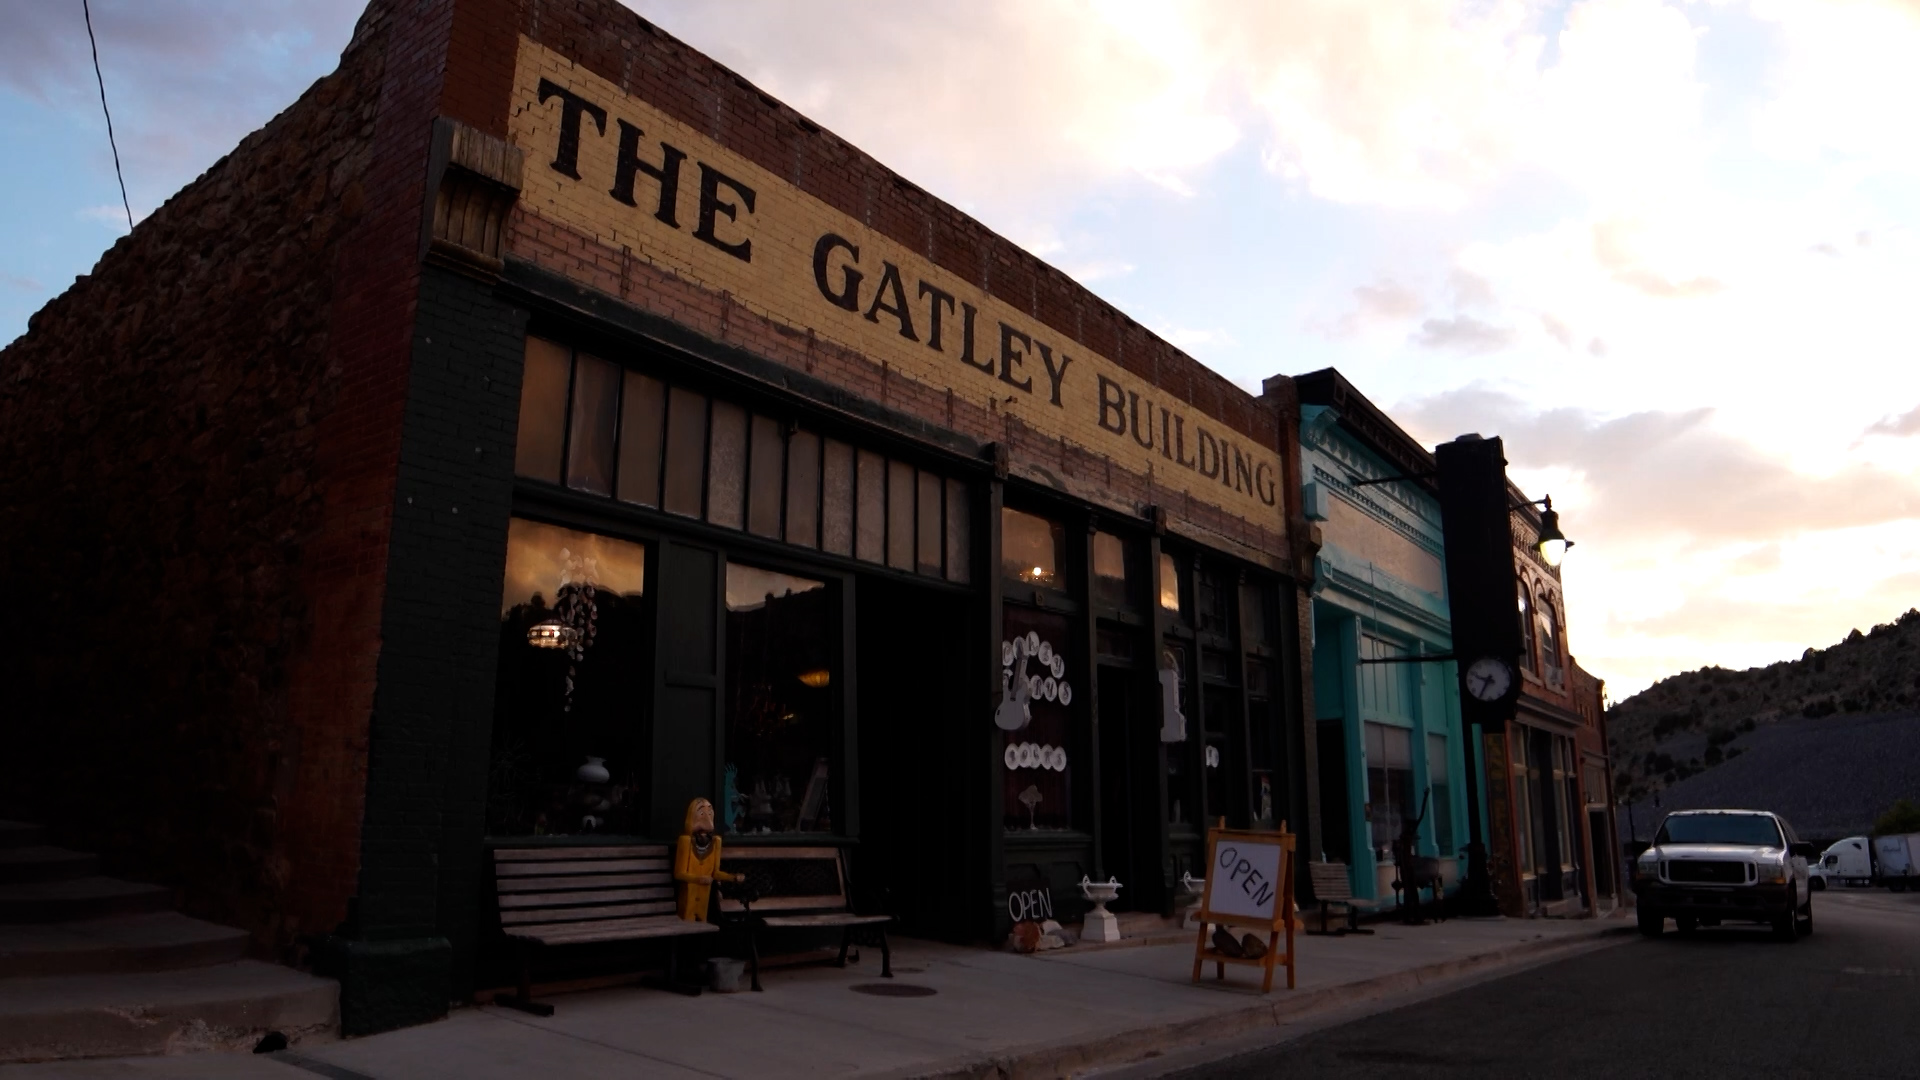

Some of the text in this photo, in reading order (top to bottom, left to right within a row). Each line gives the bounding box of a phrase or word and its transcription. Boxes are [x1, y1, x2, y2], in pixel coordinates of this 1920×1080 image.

[538, 77, 1275, 507] THE GATLEY BUILDING
[1008, 887, 1053, 923] OPEN
[1220, 847, 1274, 907] OPEN
